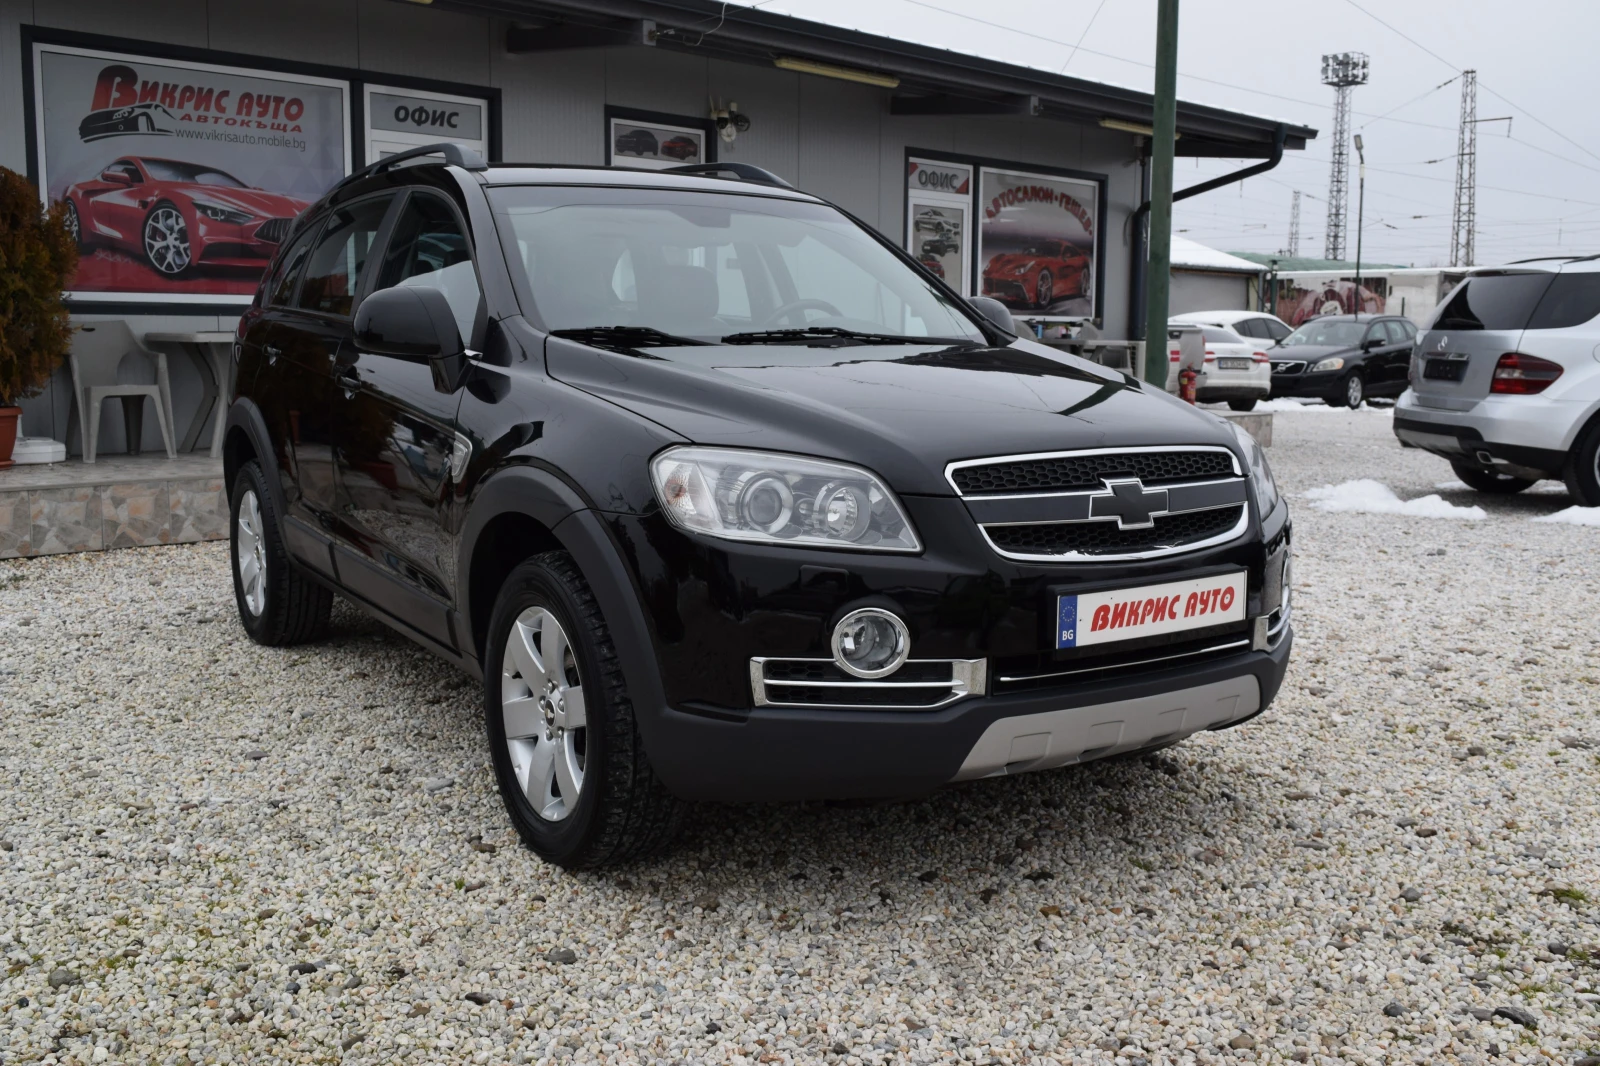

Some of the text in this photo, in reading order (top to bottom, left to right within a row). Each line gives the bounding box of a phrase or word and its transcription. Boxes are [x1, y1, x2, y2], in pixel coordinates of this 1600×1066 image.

[236, 92, 304, 122] АУТО
[394, 104, 460, 129] ОФИС
[179, 113, 303, 133] АВТОКЪЩА
[175, 128, 306, 152] www.vikrisauto.mobile.bg
[918, 169, 959, 190] ОФИС
[1090, 586, 1235, 632] ВИКРИС АУТО
[1062, 629, 1074, 641] BG
